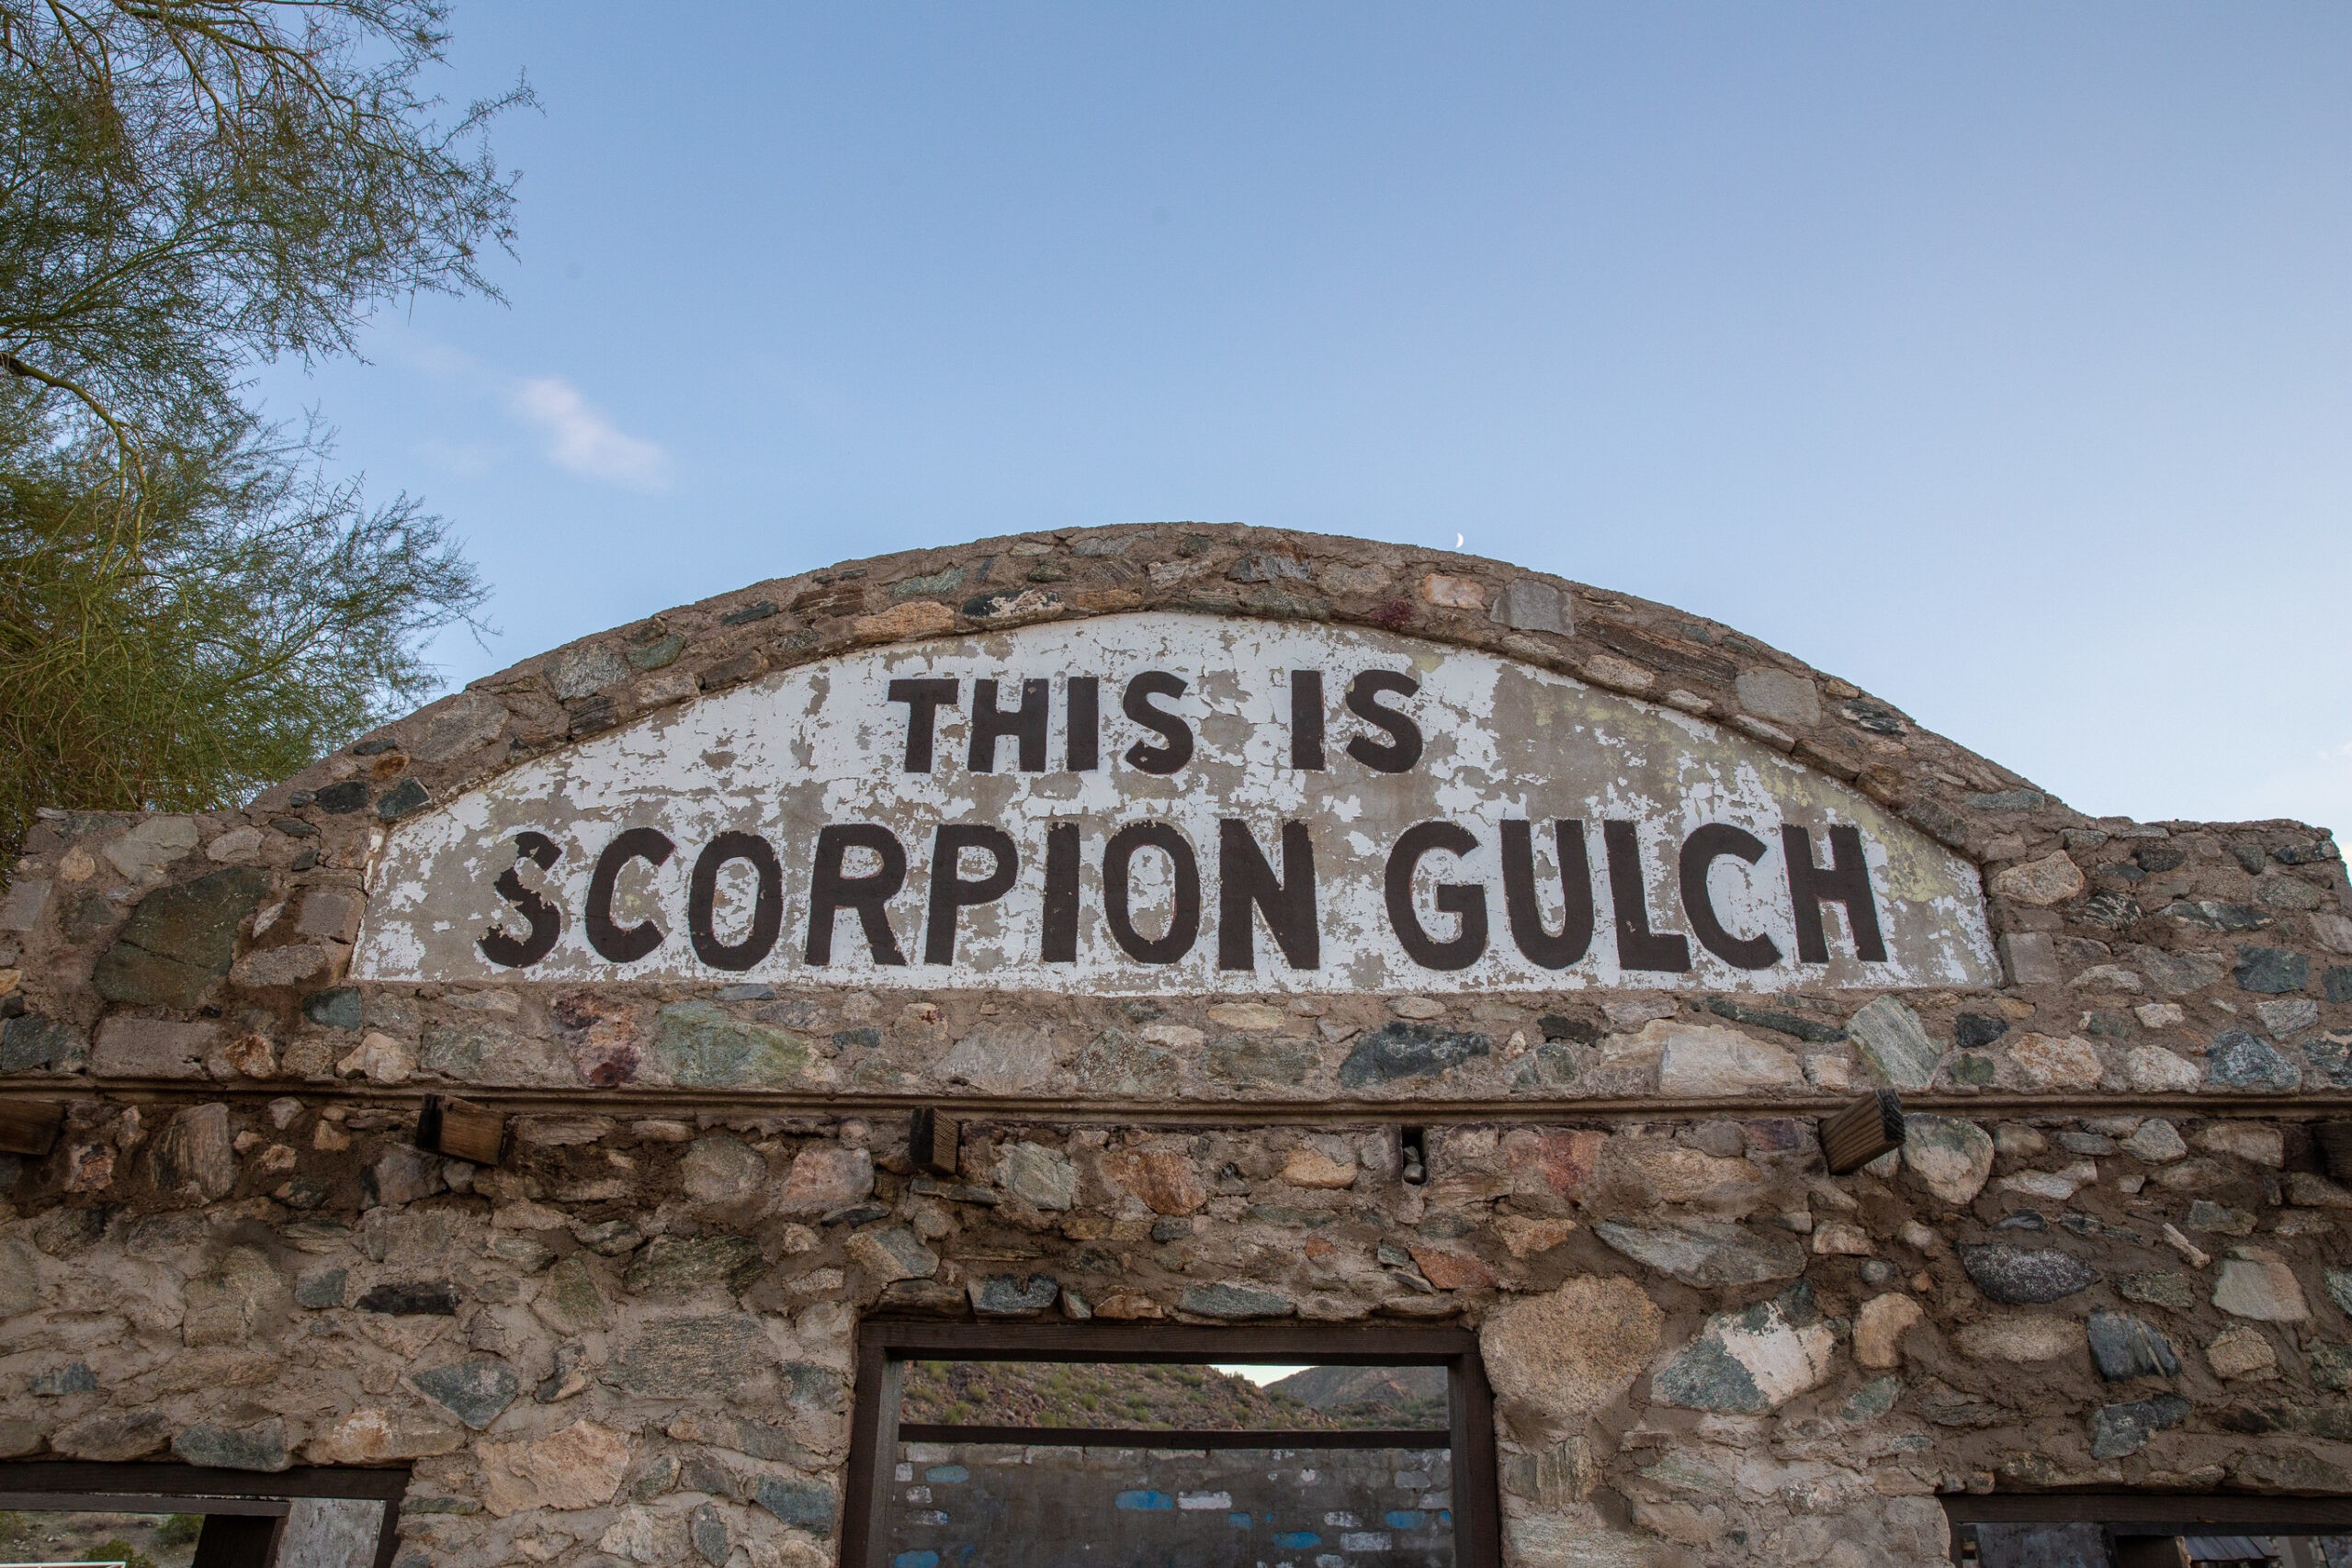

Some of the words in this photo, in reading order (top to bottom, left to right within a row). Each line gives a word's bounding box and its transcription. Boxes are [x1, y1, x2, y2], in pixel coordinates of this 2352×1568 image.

[888, 671, 1195, 775] THIS
[1291, 669, 1423, 773] IS
[476, 818, 1320, 972] SCORPION
[1384, 818, 1888, 974] GULCH
